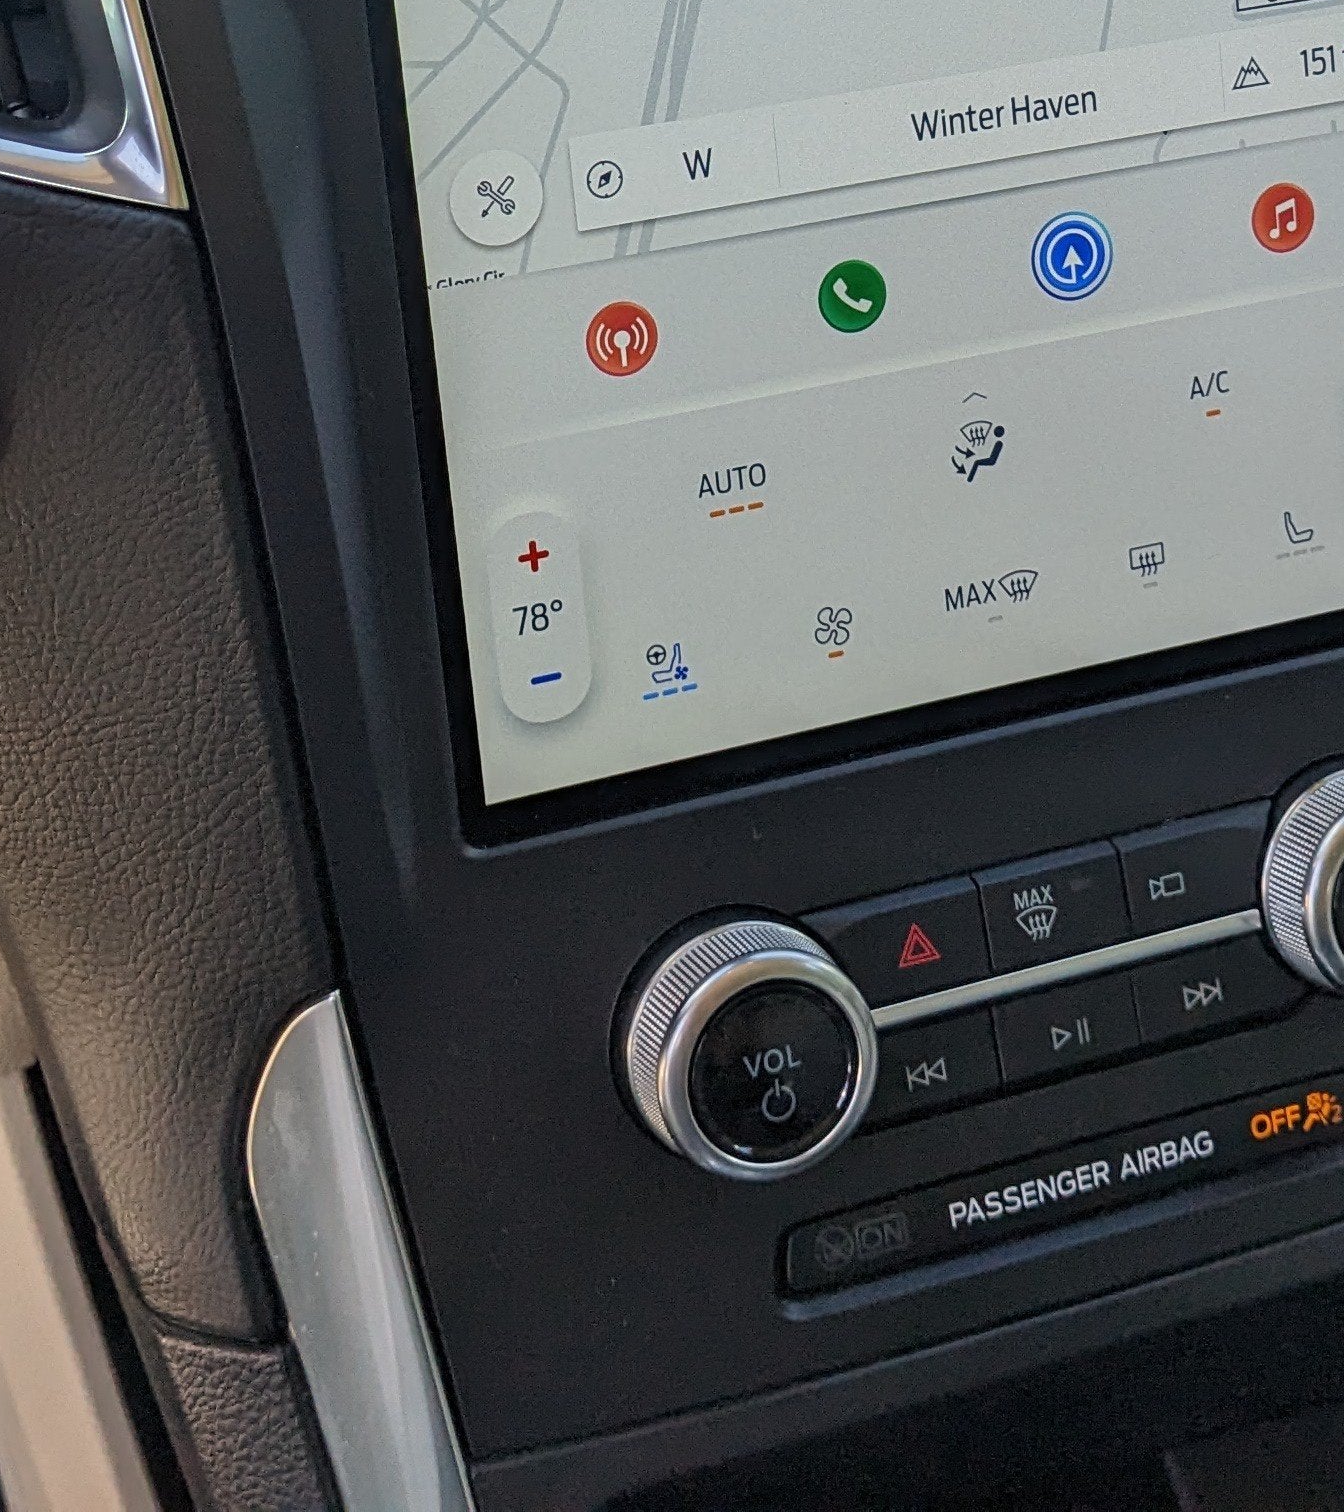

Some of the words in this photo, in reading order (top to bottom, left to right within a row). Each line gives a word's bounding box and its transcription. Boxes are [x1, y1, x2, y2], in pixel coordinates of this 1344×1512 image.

[1299, 44, 1338, 78] 151
[910, 105, 1005, 142] Winter
[1010, 90, 1098, 127] Haven
[682, 147, 713, 181] W
[1189, 370, 1231, 401] A/C
[698, 462, 767, 499] AUTO
[944, 579, 996, 612] MAX
[512, 599, 564, 637] 78°
[1013, 884, 1055, 912] MAX
[743, 1044, 802, 1078] VOL
[947, 1159, 1111, 1229] PASSENGER
[1119, 1129, 1215, 1182] AIRBAG
[1250, 1103, 1301, 1140] OFF
